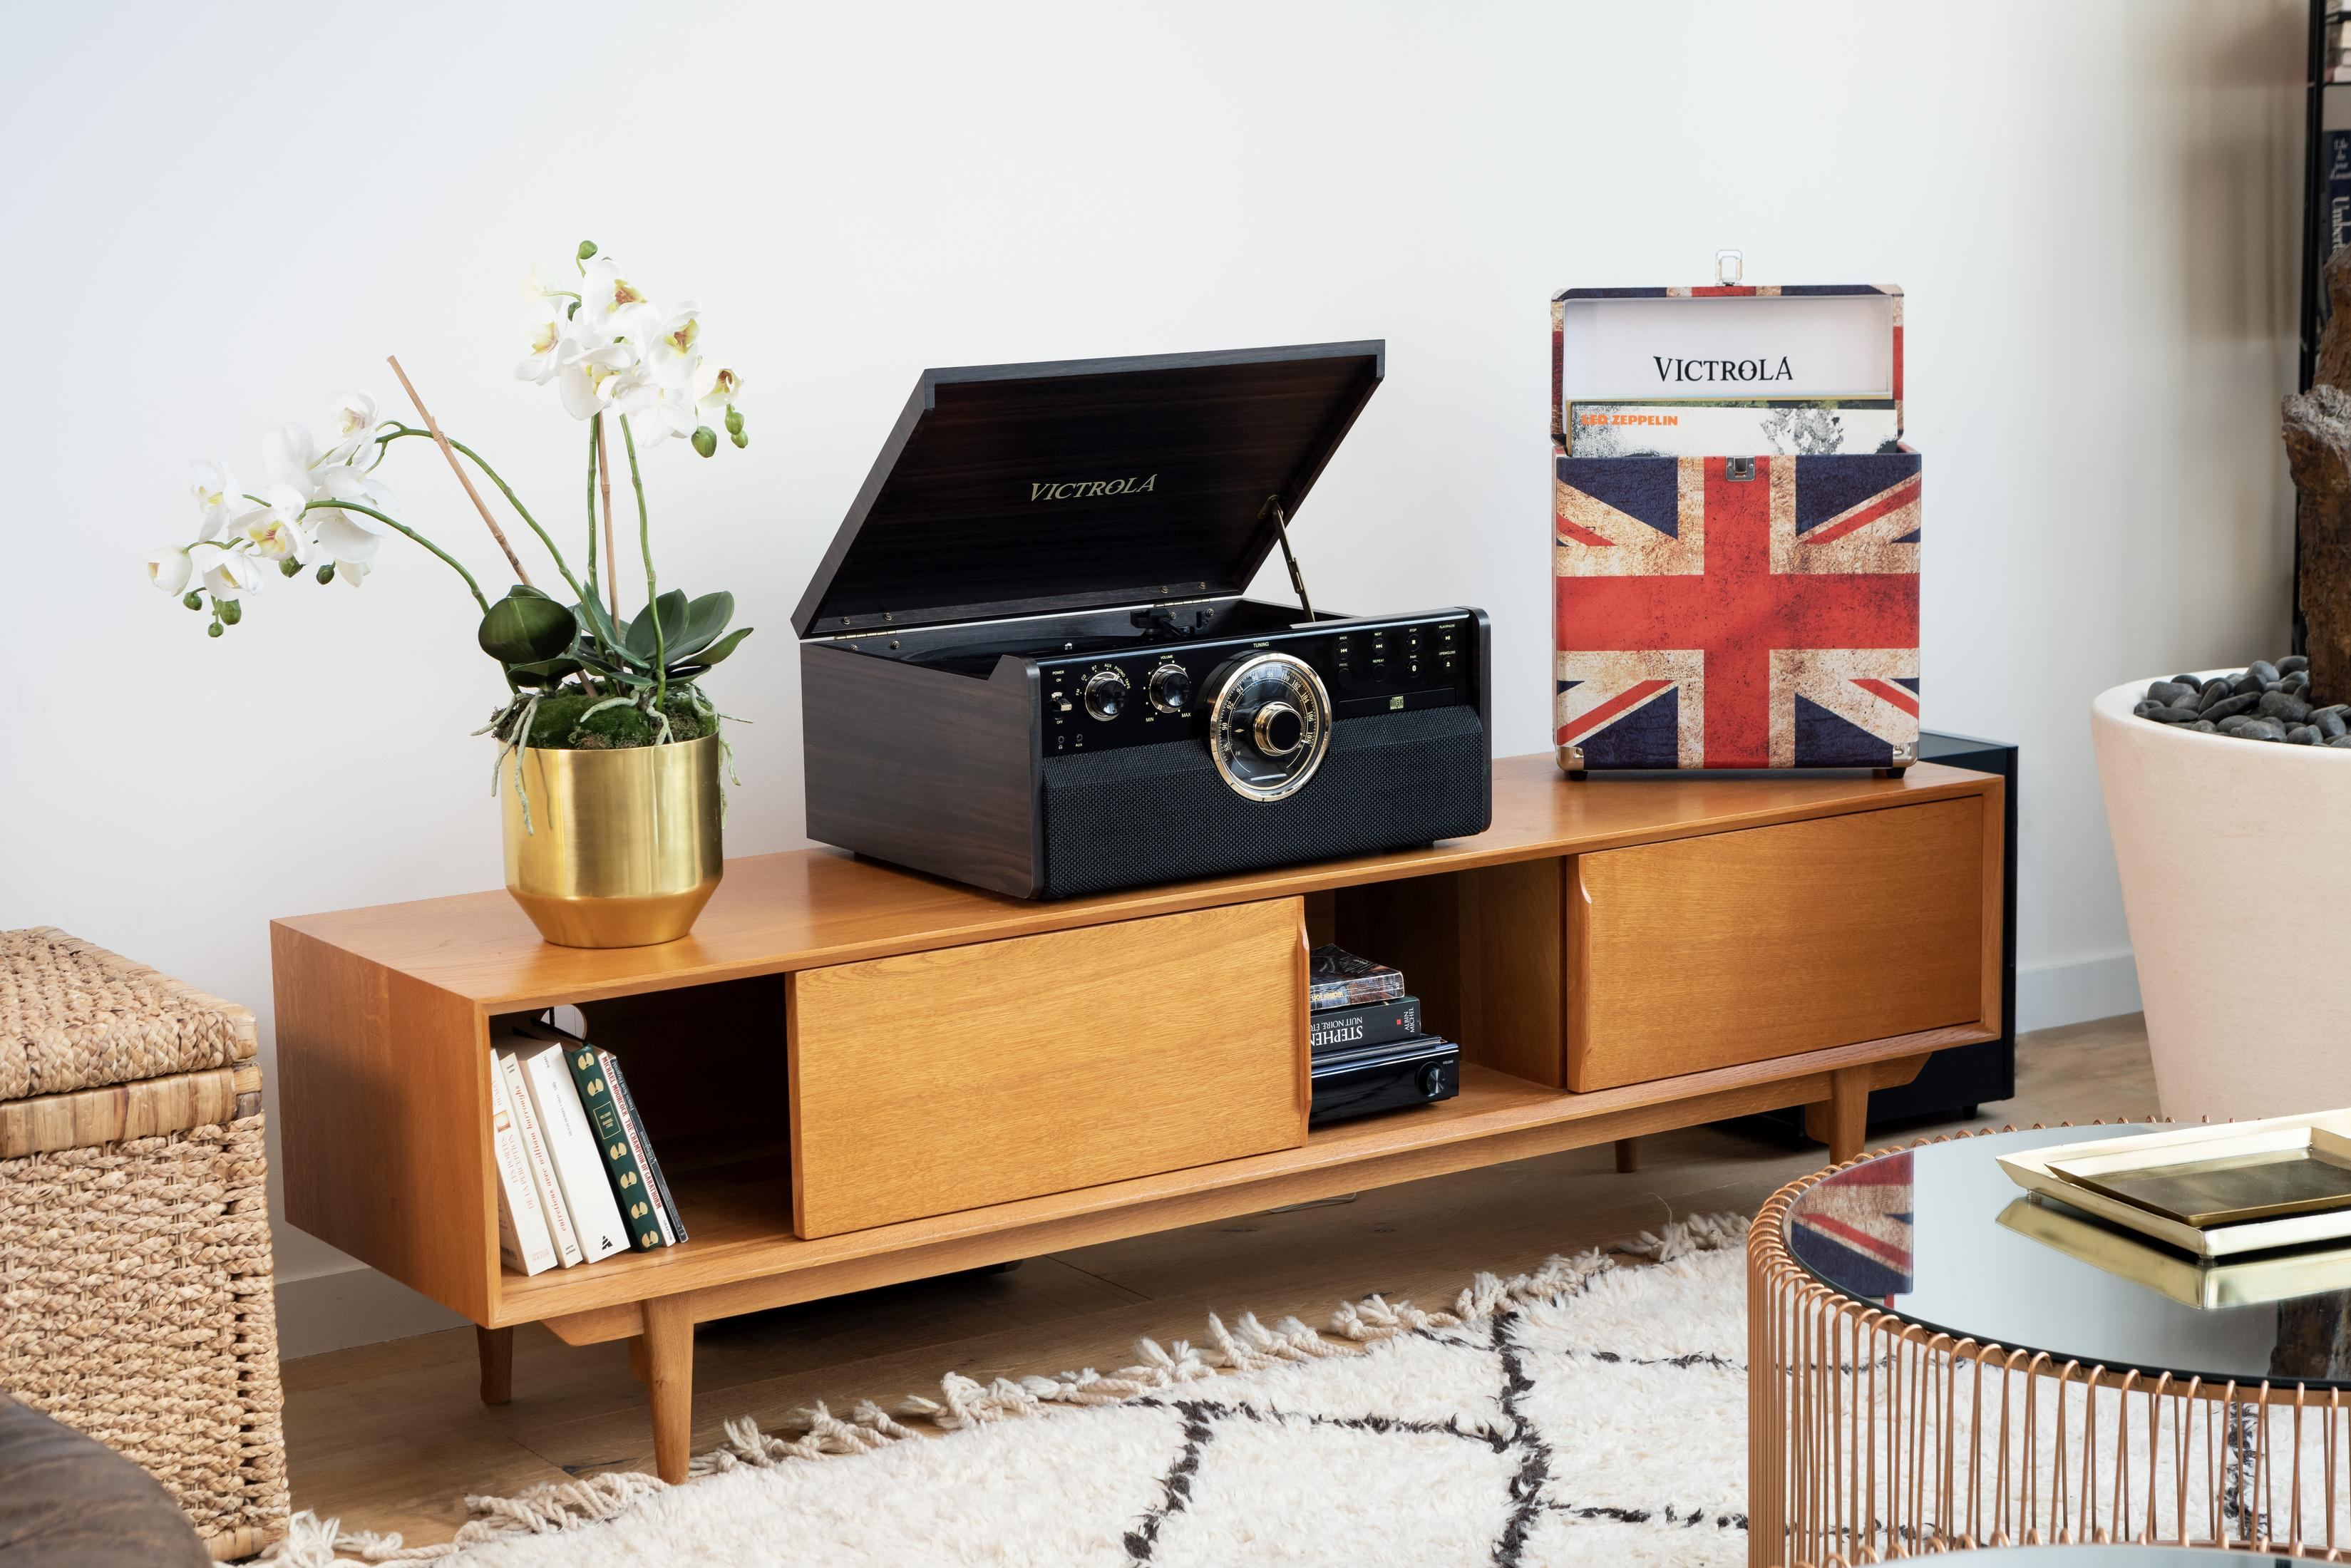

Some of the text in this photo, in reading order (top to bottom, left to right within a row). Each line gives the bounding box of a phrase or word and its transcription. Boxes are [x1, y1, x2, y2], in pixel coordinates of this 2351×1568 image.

[1652, 356, 1794, 382] VICTROLA
[1582, 414, 1678, 426] LED ZEPPELIN
[1031, 473, 1158, 502] VICTROLA
[1114, 666, 1126, 678] PHONO
[1281, 673, 1290, 681] 100
[1236, 685, 1244, 694] 94
[1292, 679, 1301, 691] 102
[1301, 692, 1310, 703] 104
[1226, 701, 1235, 710] 92
[1221, 722, 1228, 731] 90
[1223, 742, 1230, 752] 88
[1345, 1016, 1362, 1026] NUIT
[515, 1085, 533, 1130] burroughs
[602, 1056, 662, 1209] MICHAEL MOORCOCK THE CHAMPION OF GARATHORM
[531, 1132, 545, 1165] william
[542, 1168, 552, 1187] avec
[662, 1219, 672, 1241] GRAFTON
